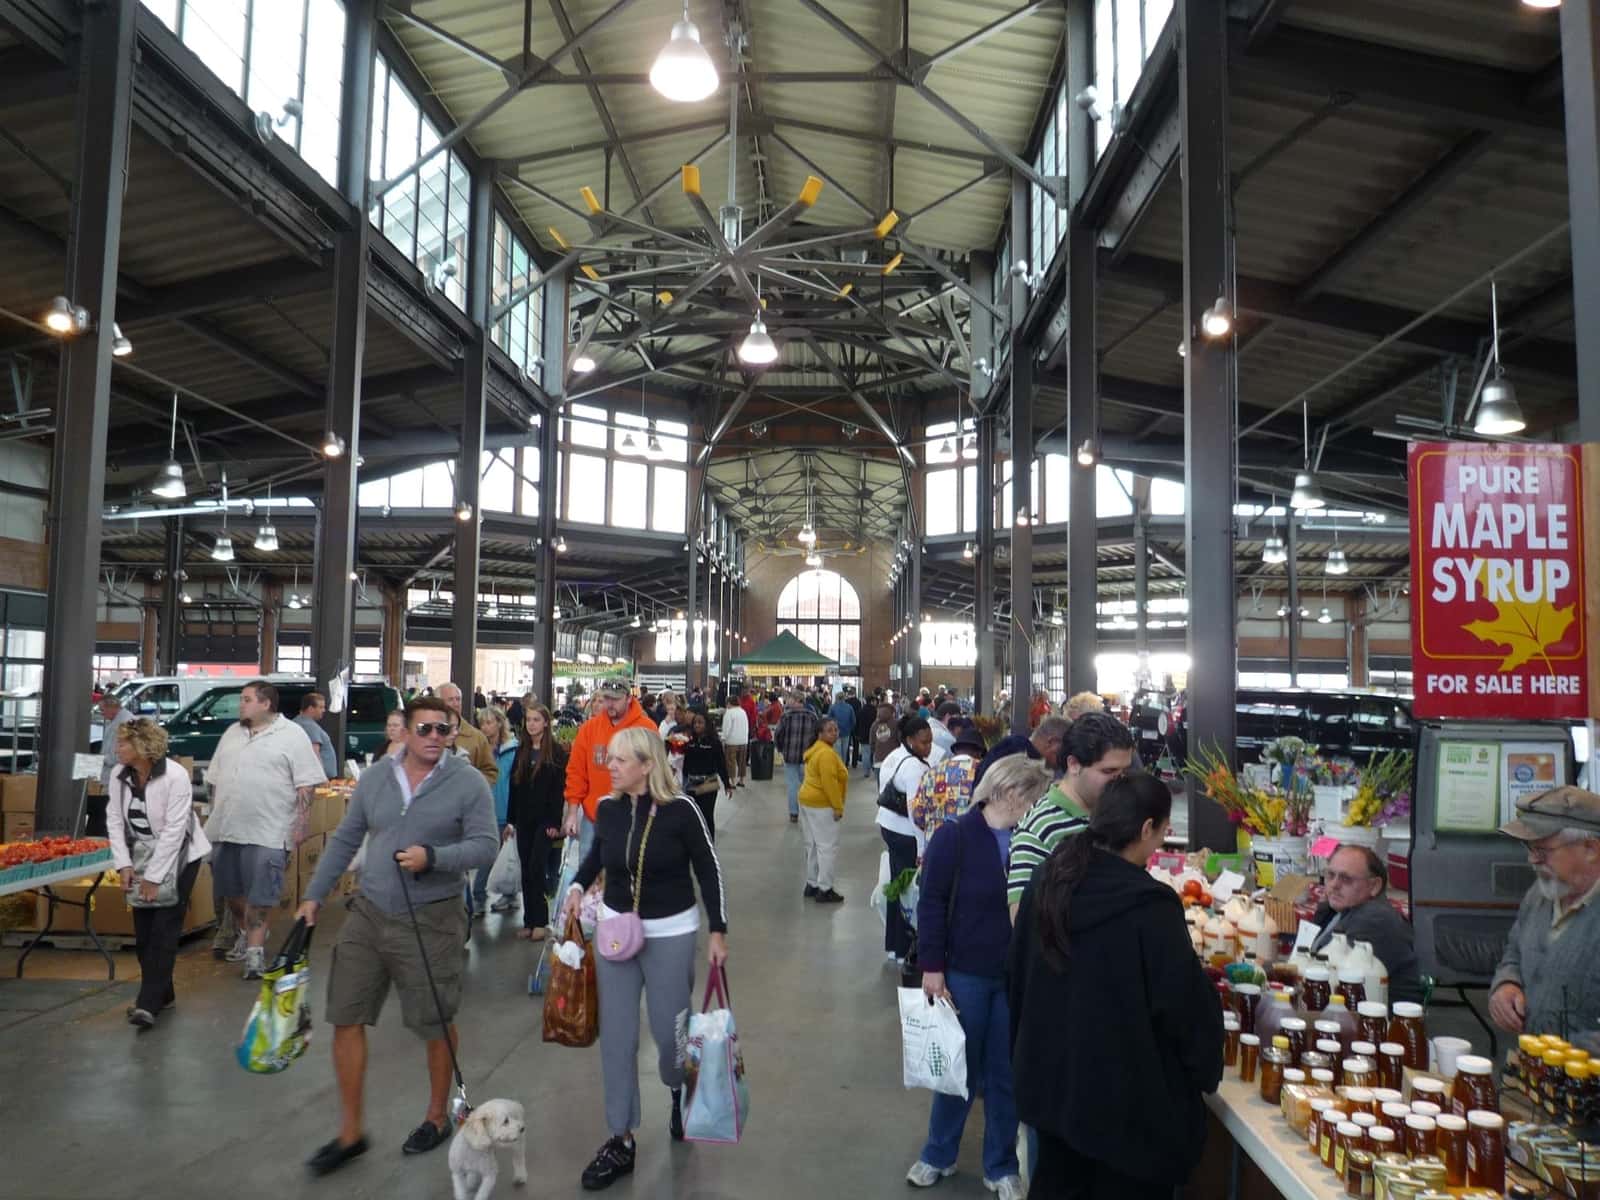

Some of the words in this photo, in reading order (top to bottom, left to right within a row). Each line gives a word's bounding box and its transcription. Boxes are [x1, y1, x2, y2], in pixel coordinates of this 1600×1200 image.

[1459, 466, 1540, 494] PURE
[1431, 503, 1568, 550] MAPLE
[1432, 557, 1570, 603] SYRUP
[1427, 674, 1468, 694] FOR
[1475, 675, 1523, 694] SALE
[1530, 674, 1580, 694] HERE
